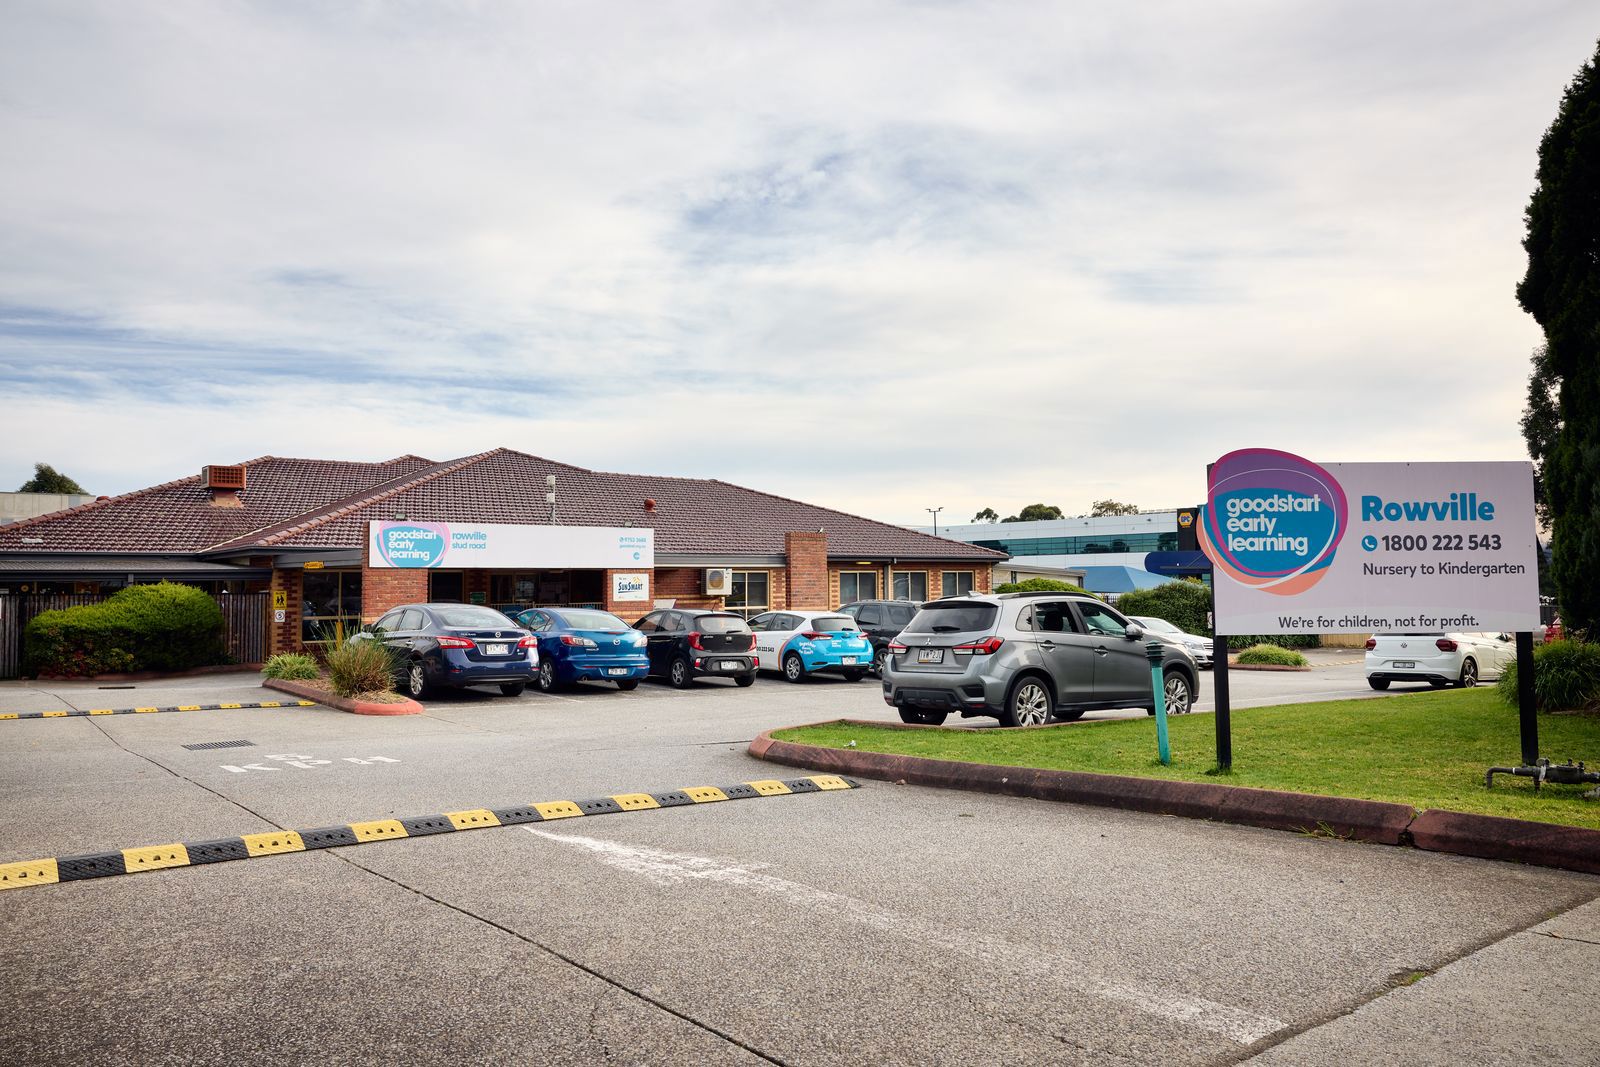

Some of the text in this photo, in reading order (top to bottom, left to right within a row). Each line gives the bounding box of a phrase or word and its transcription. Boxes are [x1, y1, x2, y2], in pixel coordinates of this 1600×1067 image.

[1226, 494, 1321, 518] goodstart
[1361, 492, 1495, 522] Rowville
[1226, 514, 1277, 536] early
[388, 529, 437, 541] goodstart
[452, 531, 487, 541] rowville
[1381, 534, 1502, 551] 1800 222 543
[388, 540, 415, 550] early
[452, 541, 486, 550] stud road
[1228, 533, 1308, 556] learning
[388, 549, 430, 561] learning
[1363, 561, 1525, 578] Nursery to Kindergarten
[1278, 614, 1480, 629] We're for children, not for profit.
